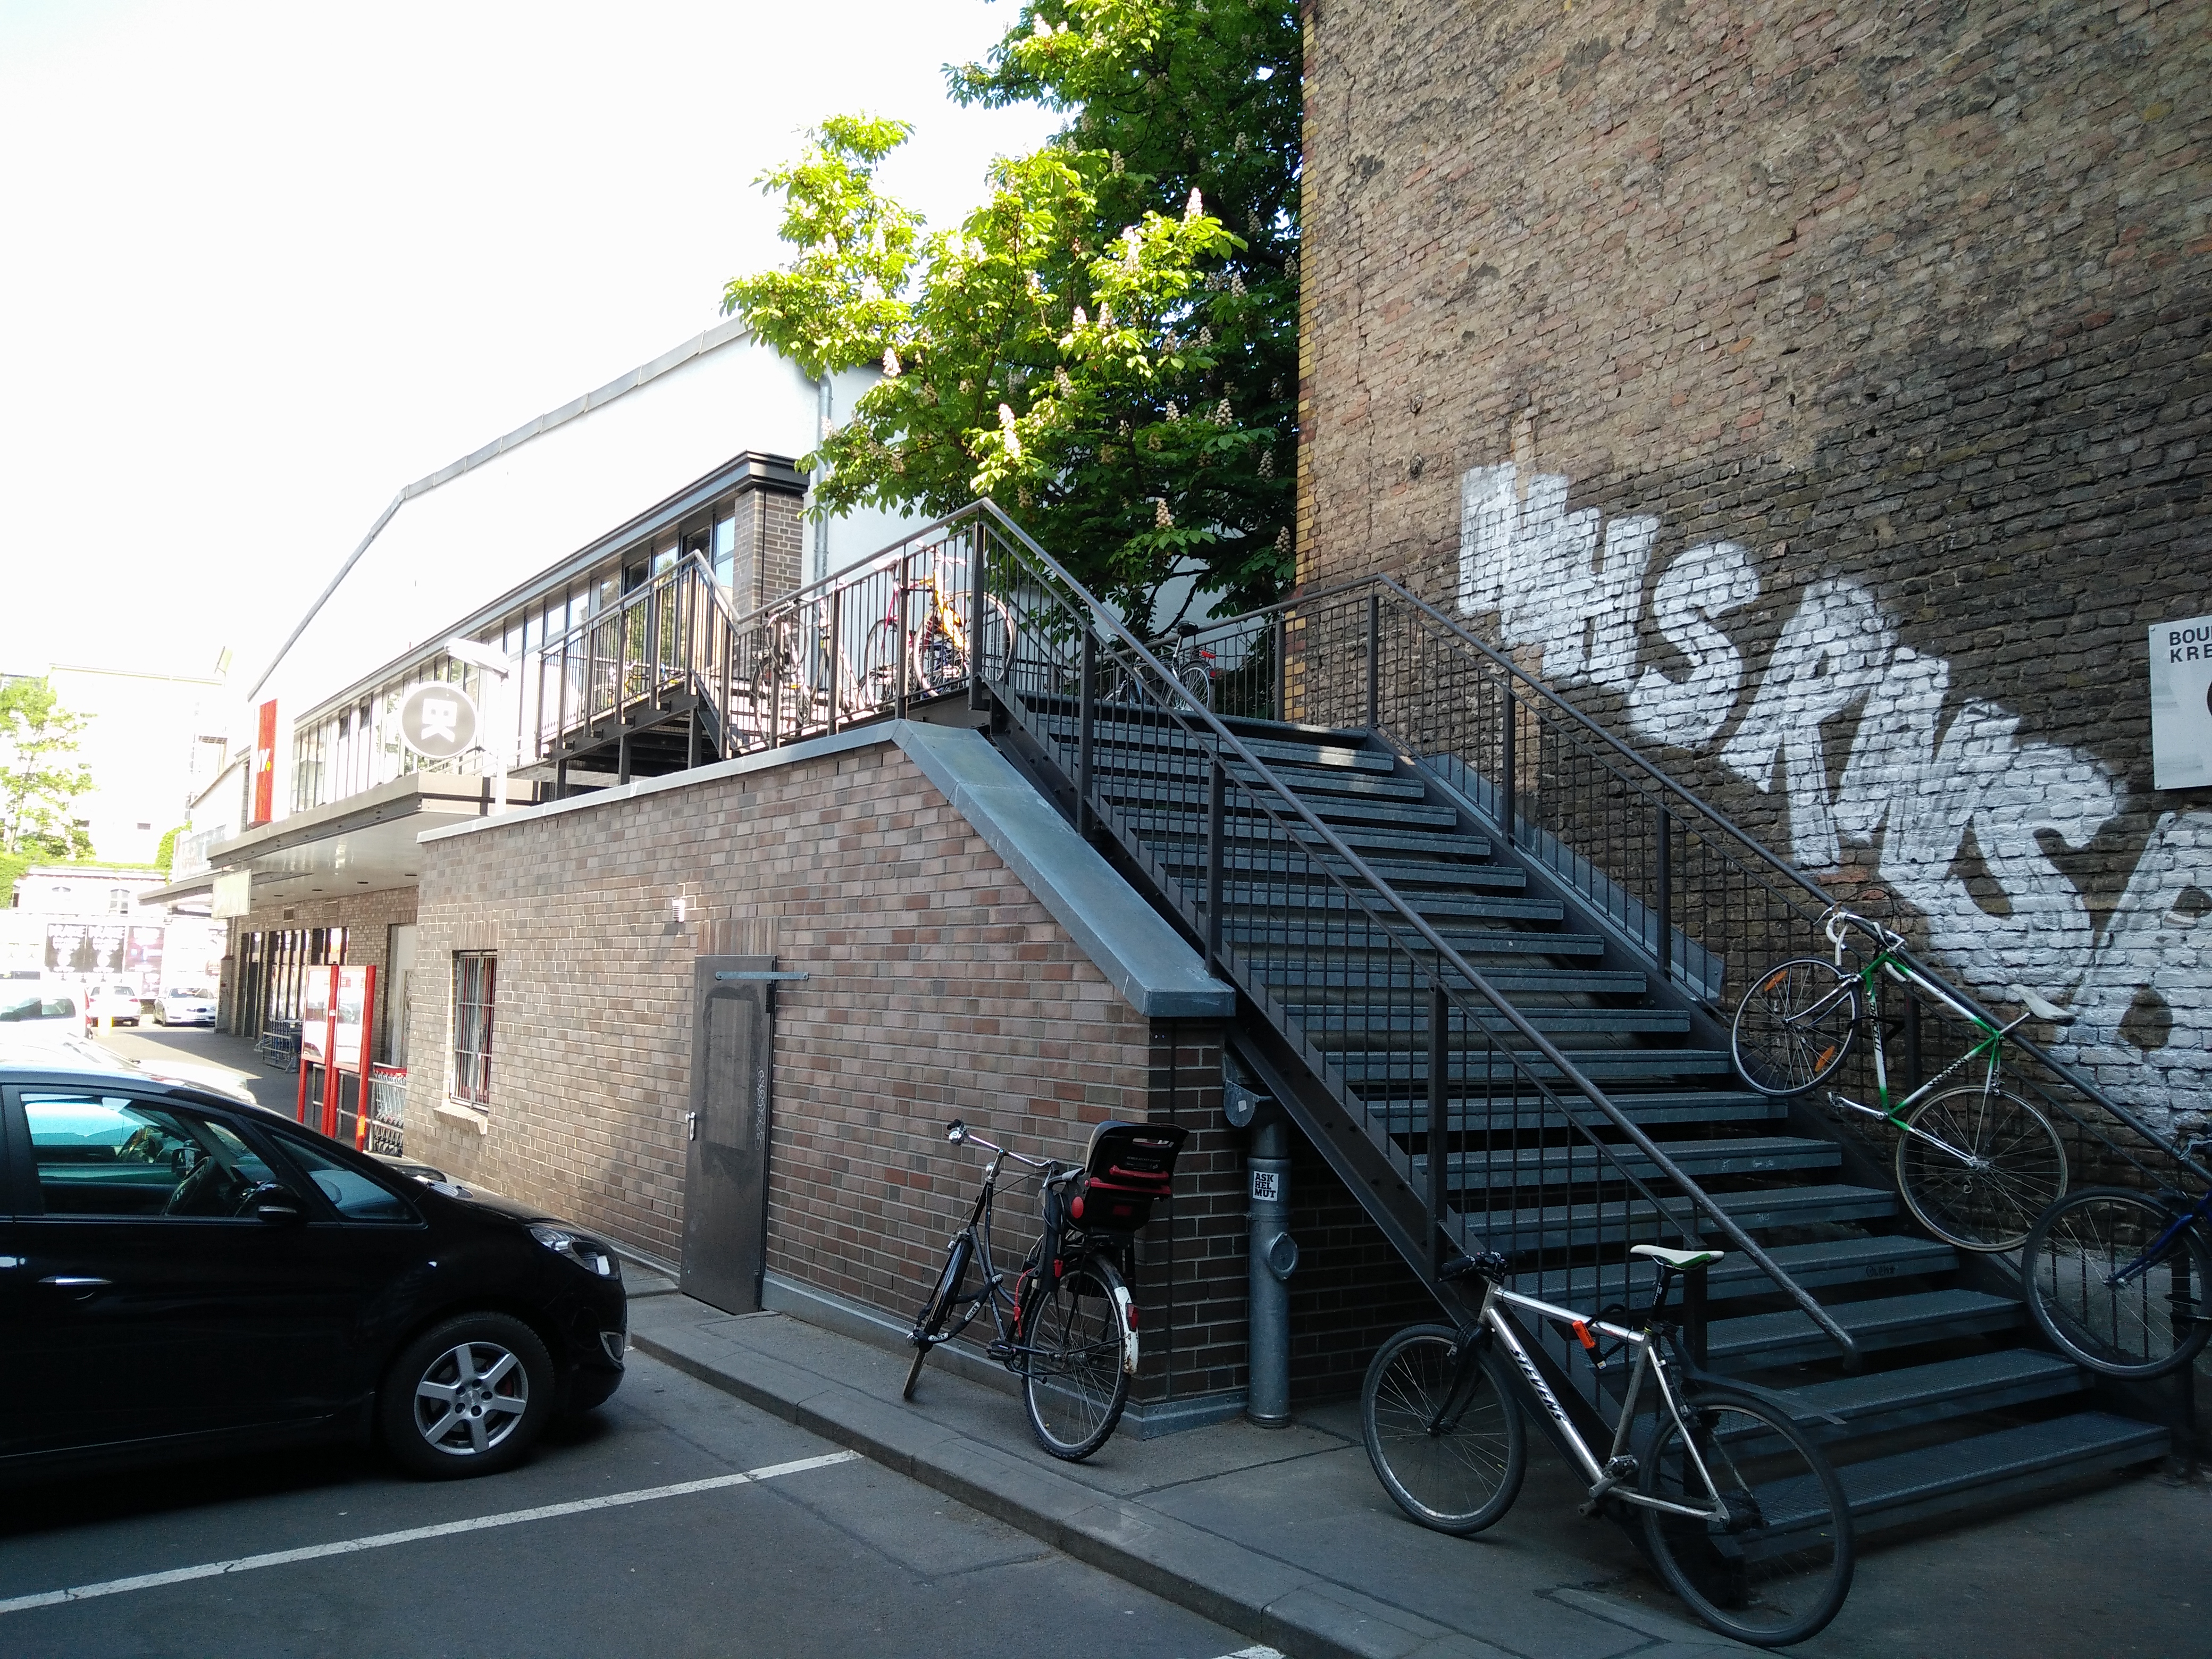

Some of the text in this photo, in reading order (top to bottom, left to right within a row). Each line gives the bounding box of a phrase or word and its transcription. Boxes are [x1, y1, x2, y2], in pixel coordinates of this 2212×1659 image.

[2169, 626, 2212, 646] BOU
[1255, 1173, 1274, 1182] ASK
[1255, 1181, 1271, 1189] HEL
[1254, 1188, 1276, 1197] MUT
[1510, 1348, 1565, 1421] STEVENS
